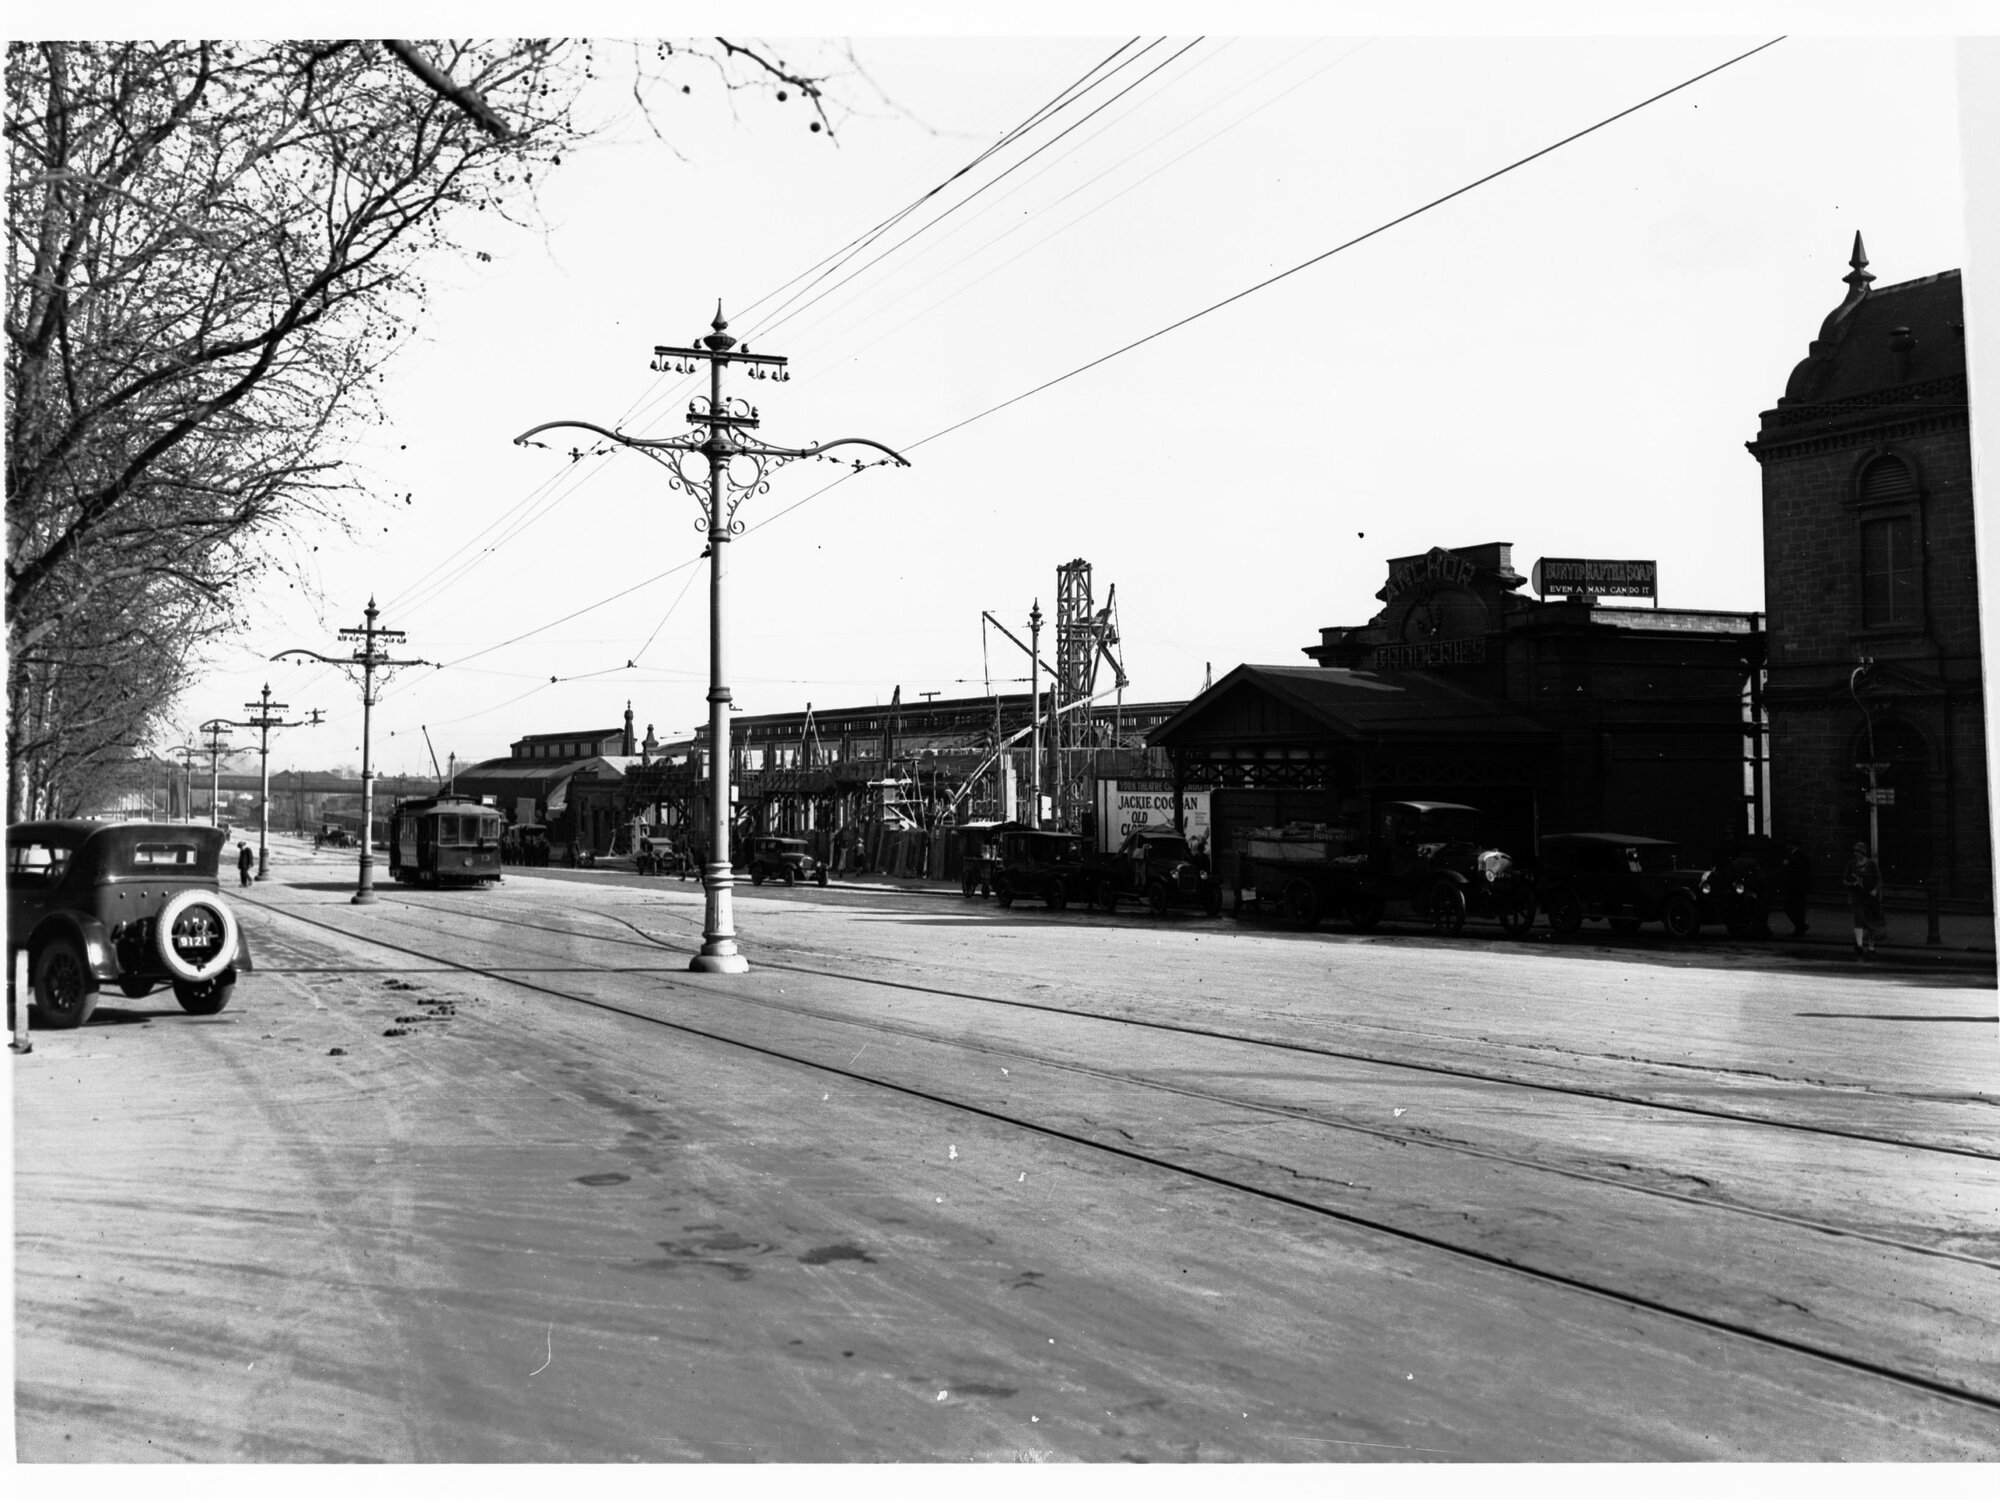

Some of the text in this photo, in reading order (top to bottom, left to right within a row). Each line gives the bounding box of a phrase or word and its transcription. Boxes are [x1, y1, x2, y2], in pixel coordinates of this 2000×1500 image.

[1386, 554, 1476, 602] ANCHOR
[1545, 563, 1586, 580] BUNYIP
[1627, 564, 1654, 581] SOAP
[1550, 585, 1573, 593] EVEN
[1576, 585, 1584, 593] A
[1610, 586, 1627, 594] CAN
[1375, 638, 1485, 669] GROCERIES
[1137, 781, 1162, 792] THEATRE
[1118, 795, 1198, 810] JACKIE COOAN
[180, 936, 207, 947] 9121
